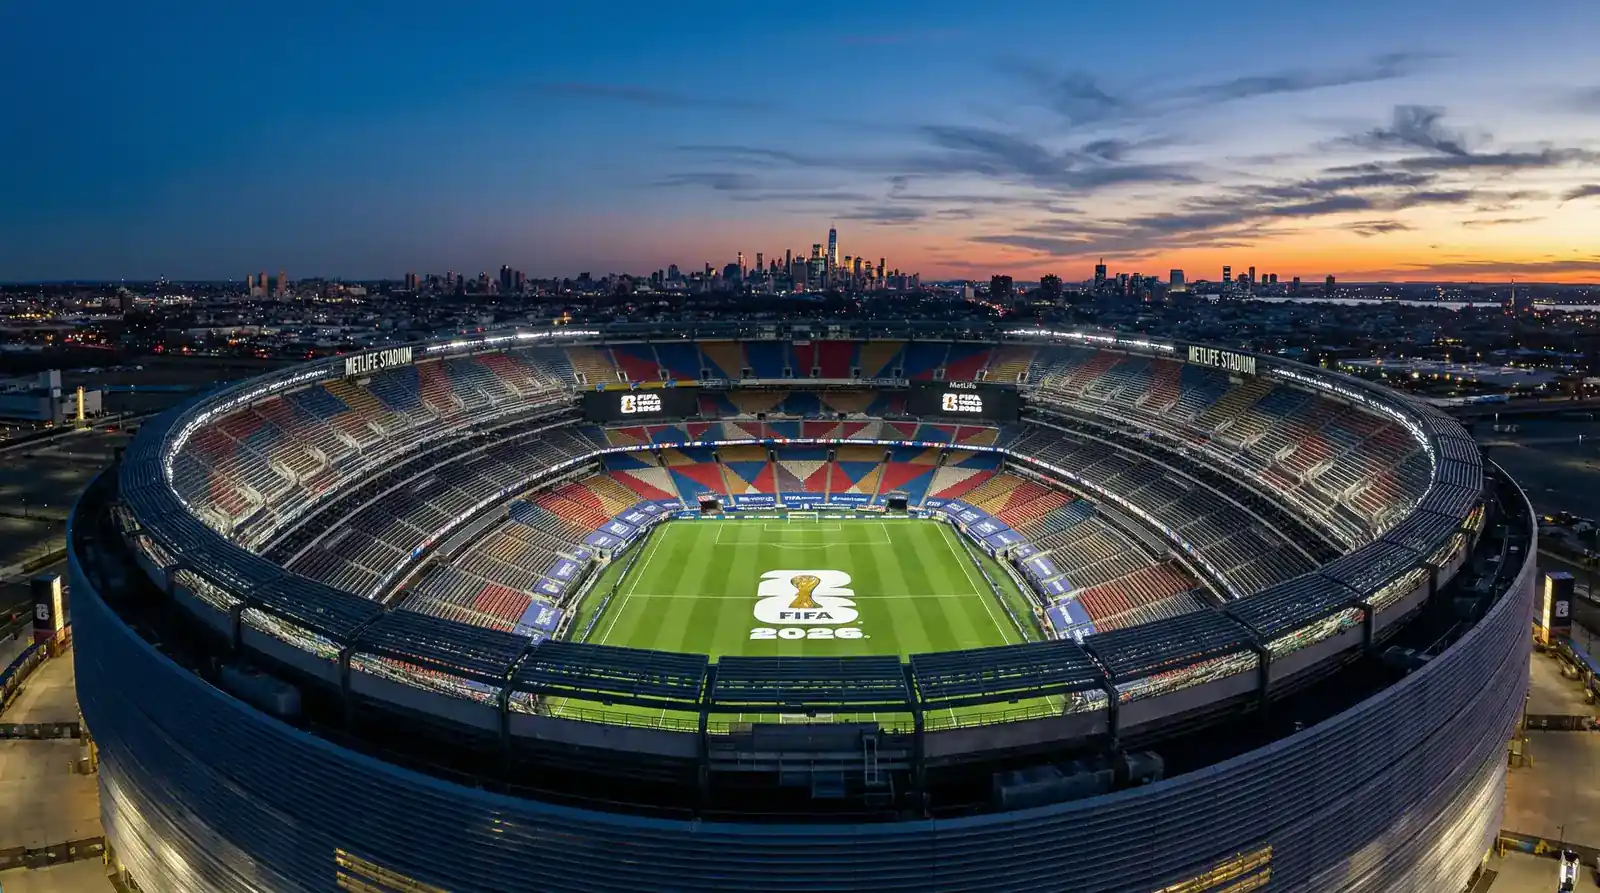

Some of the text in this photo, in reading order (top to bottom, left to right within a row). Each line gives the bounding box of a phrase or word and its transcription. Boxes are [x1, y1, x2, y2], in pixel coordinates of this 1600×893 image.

[345, 346, 412, 376] METLIFE STADIUM
[1188, 345, 1256, 375] METLIFE STADIUM
[780, 611, 833, 620] FIFA
[749, 627, 864, 640] 2026
